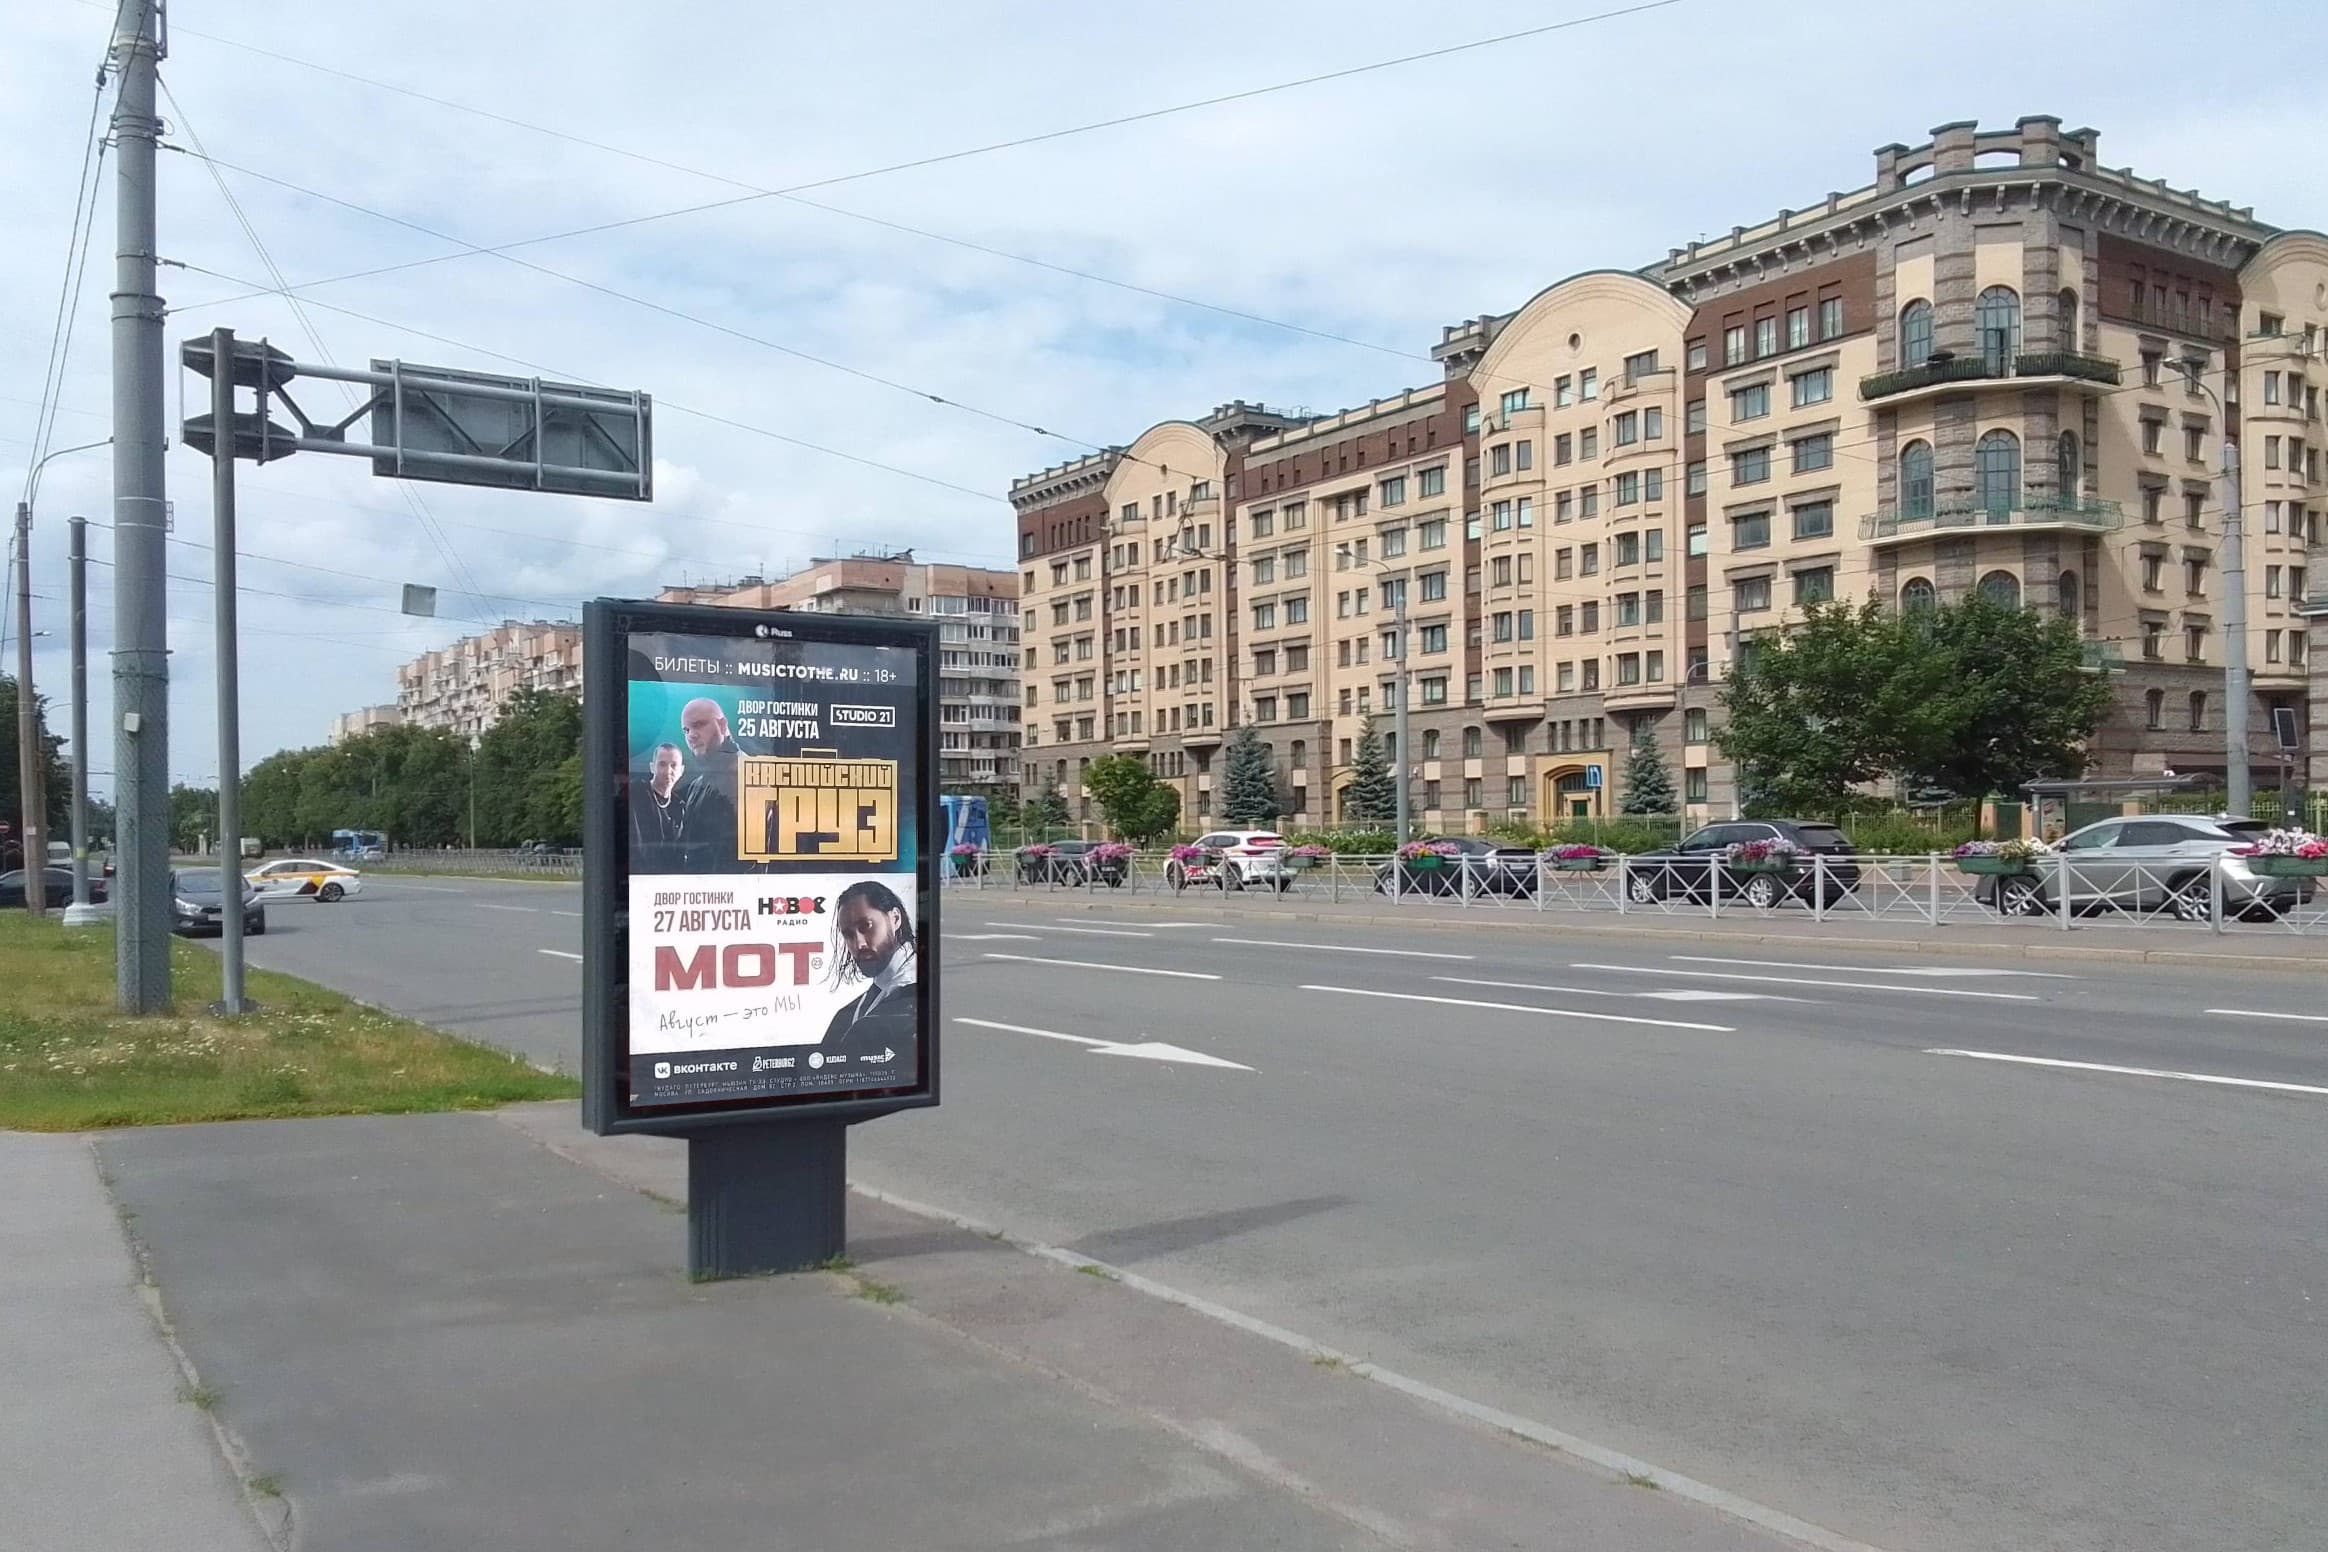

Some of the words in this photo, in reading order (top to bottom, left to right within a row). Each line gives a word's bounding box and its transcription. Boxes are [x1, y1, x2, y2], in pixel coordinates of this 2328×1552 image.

[654, 656, 720, 674] БИЛЕТЫ
[738, 662, 858, 681] MUSICTOTHE.RU
[874, 669, 897, 683] 18+
[737, 700, 766, 715] ДВОР
[767, 701, 818, 717] ГОСТИНКИ
[836, 709, 877, 722] STUDIO
[879, 711, 891, 723] 21
[738, 718, 756, 737] 25
[759, 719, 820, 740] АВГУСТА
[745, 762, 892, 787] КАСПИЙСКИЙ
[745, 787, 892, 854] ГРУЗ
[654, 892, 682, 906] ДВОР
[684, 891, 734, 905] ГОСТИНКИ
[654, 910, 675, 932] 27
[679, 909, 751, 932] АВГУСТА
[776, 918, 809, 926] РАДИО
[655, 941, 824, 991] МОТ
[659, 1010, 718, 1038] Август
[743, 1006, 769, 1020] это
[774, 993, 801, 1013] МЫ
